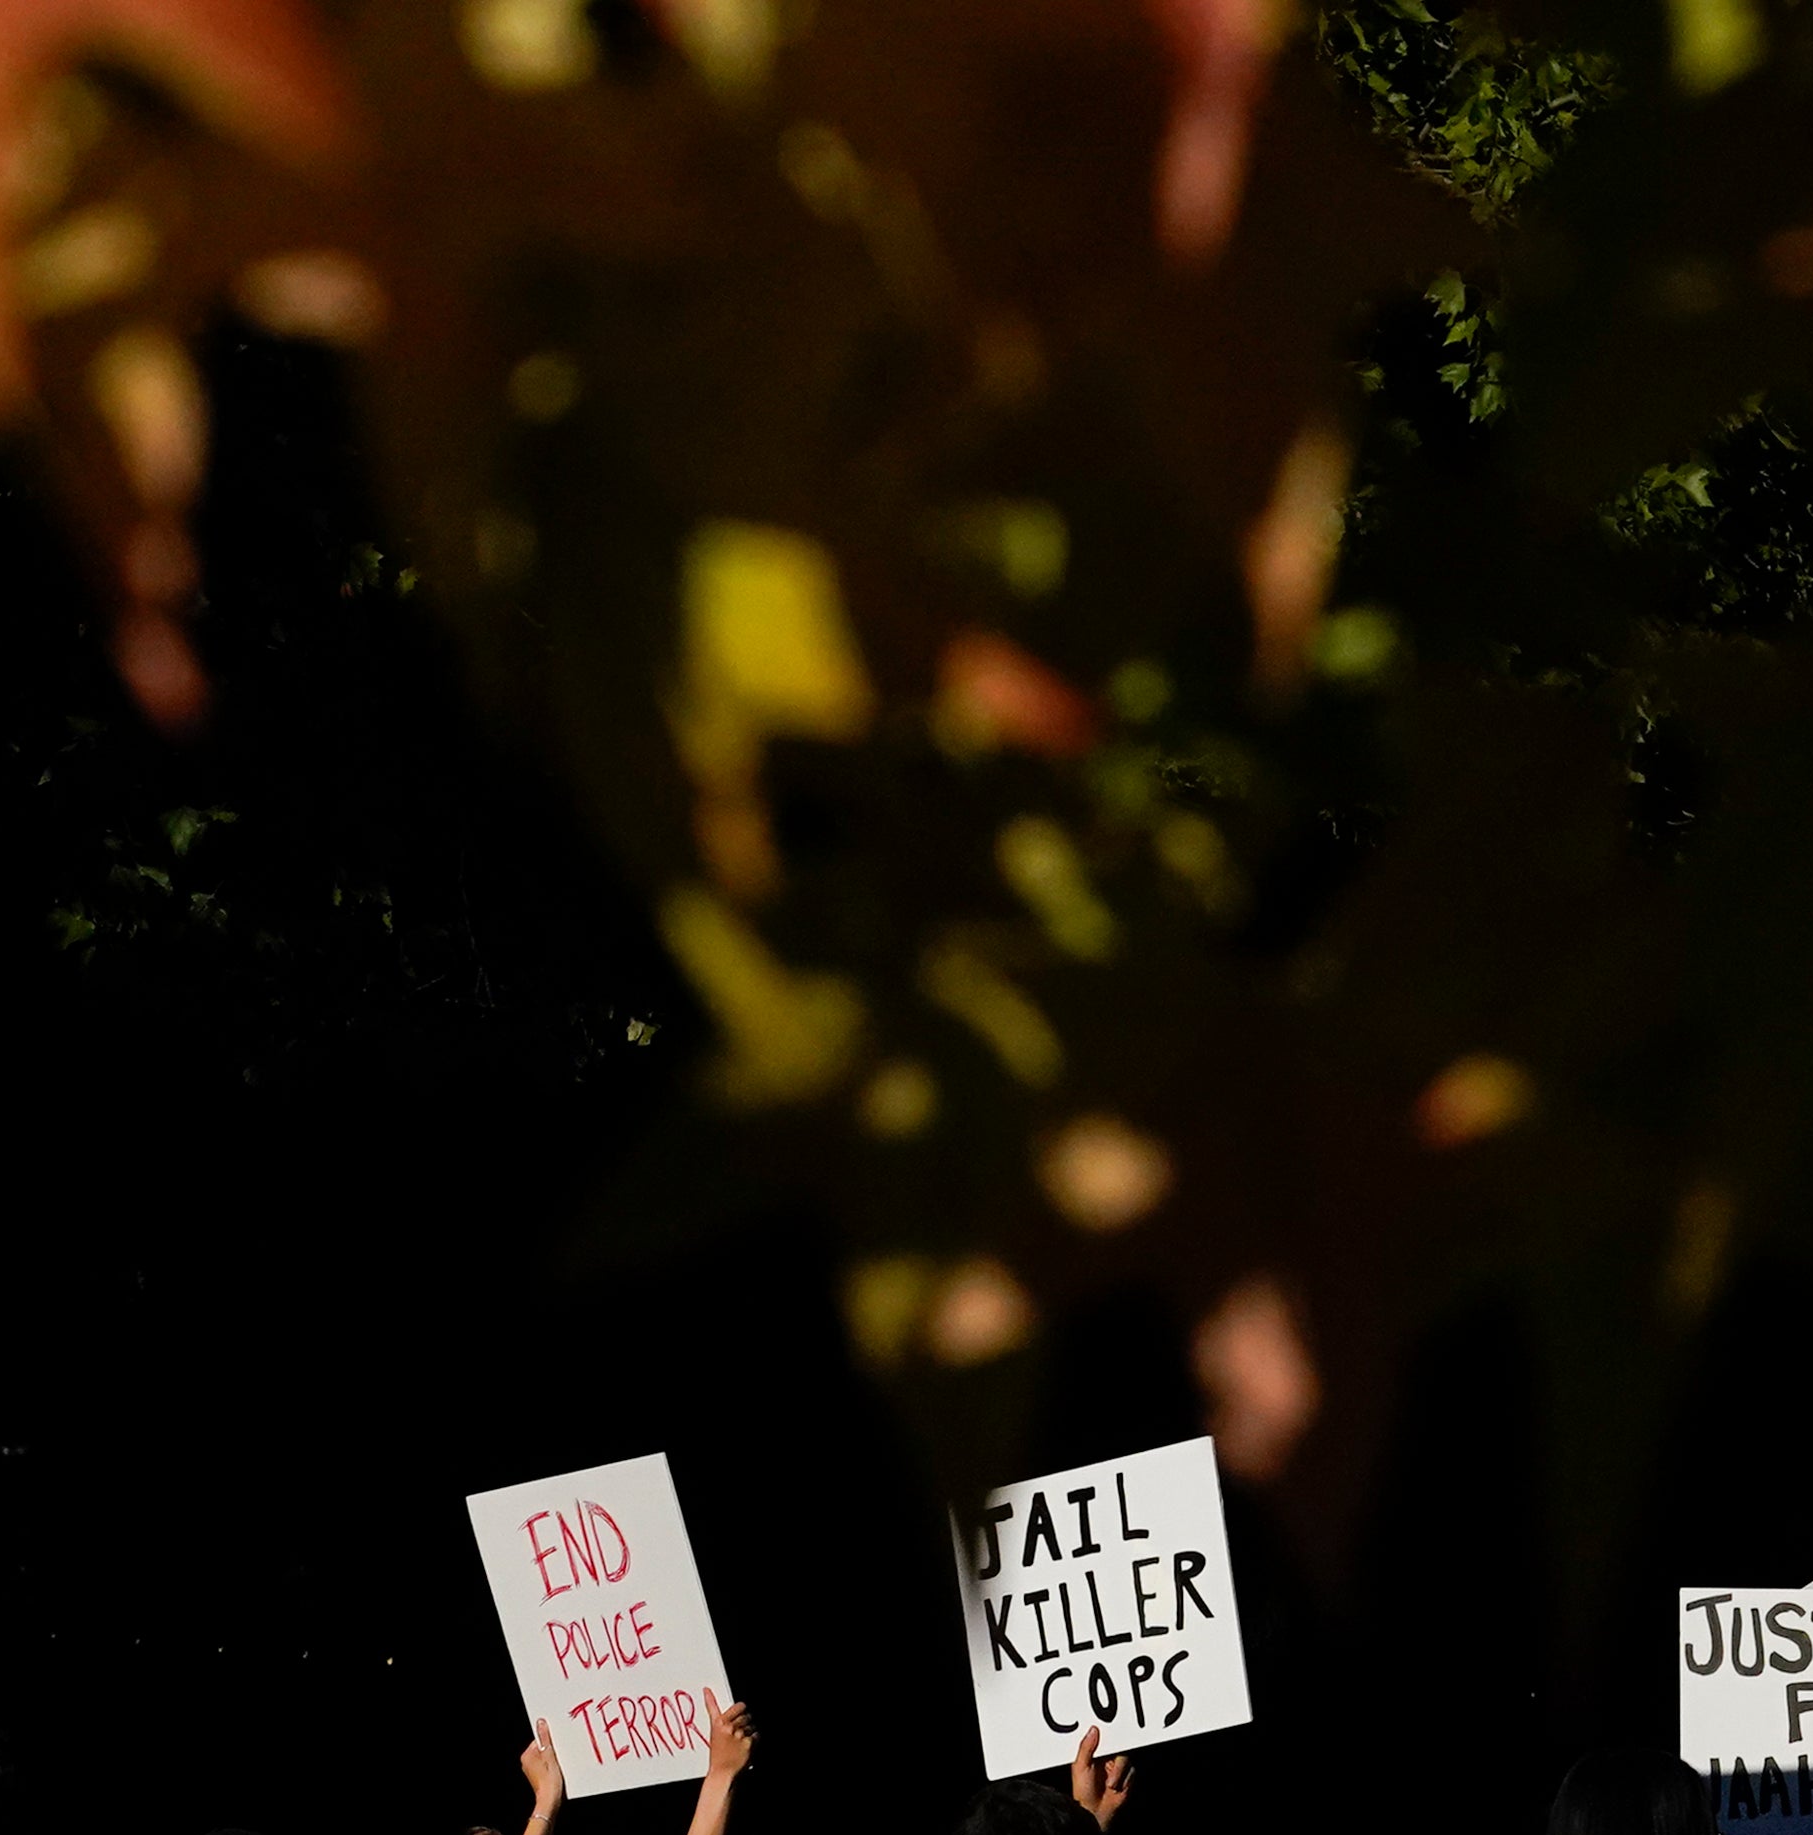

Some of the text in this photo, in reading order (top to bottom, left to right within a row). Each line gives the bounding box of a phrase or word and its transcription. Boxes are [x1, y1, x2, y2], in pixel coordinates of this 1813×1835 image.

[517, 1498, 631, 1607] END
[978, 1473, 1149, 1580] JAIL
[544, 1601, 662, 1680] POLICE
[984, 1551, 1215, 1672] KILLER
[569, 1689, 711, 1765] TERROR
[1042, 1650, 1190, 1733] COPS
